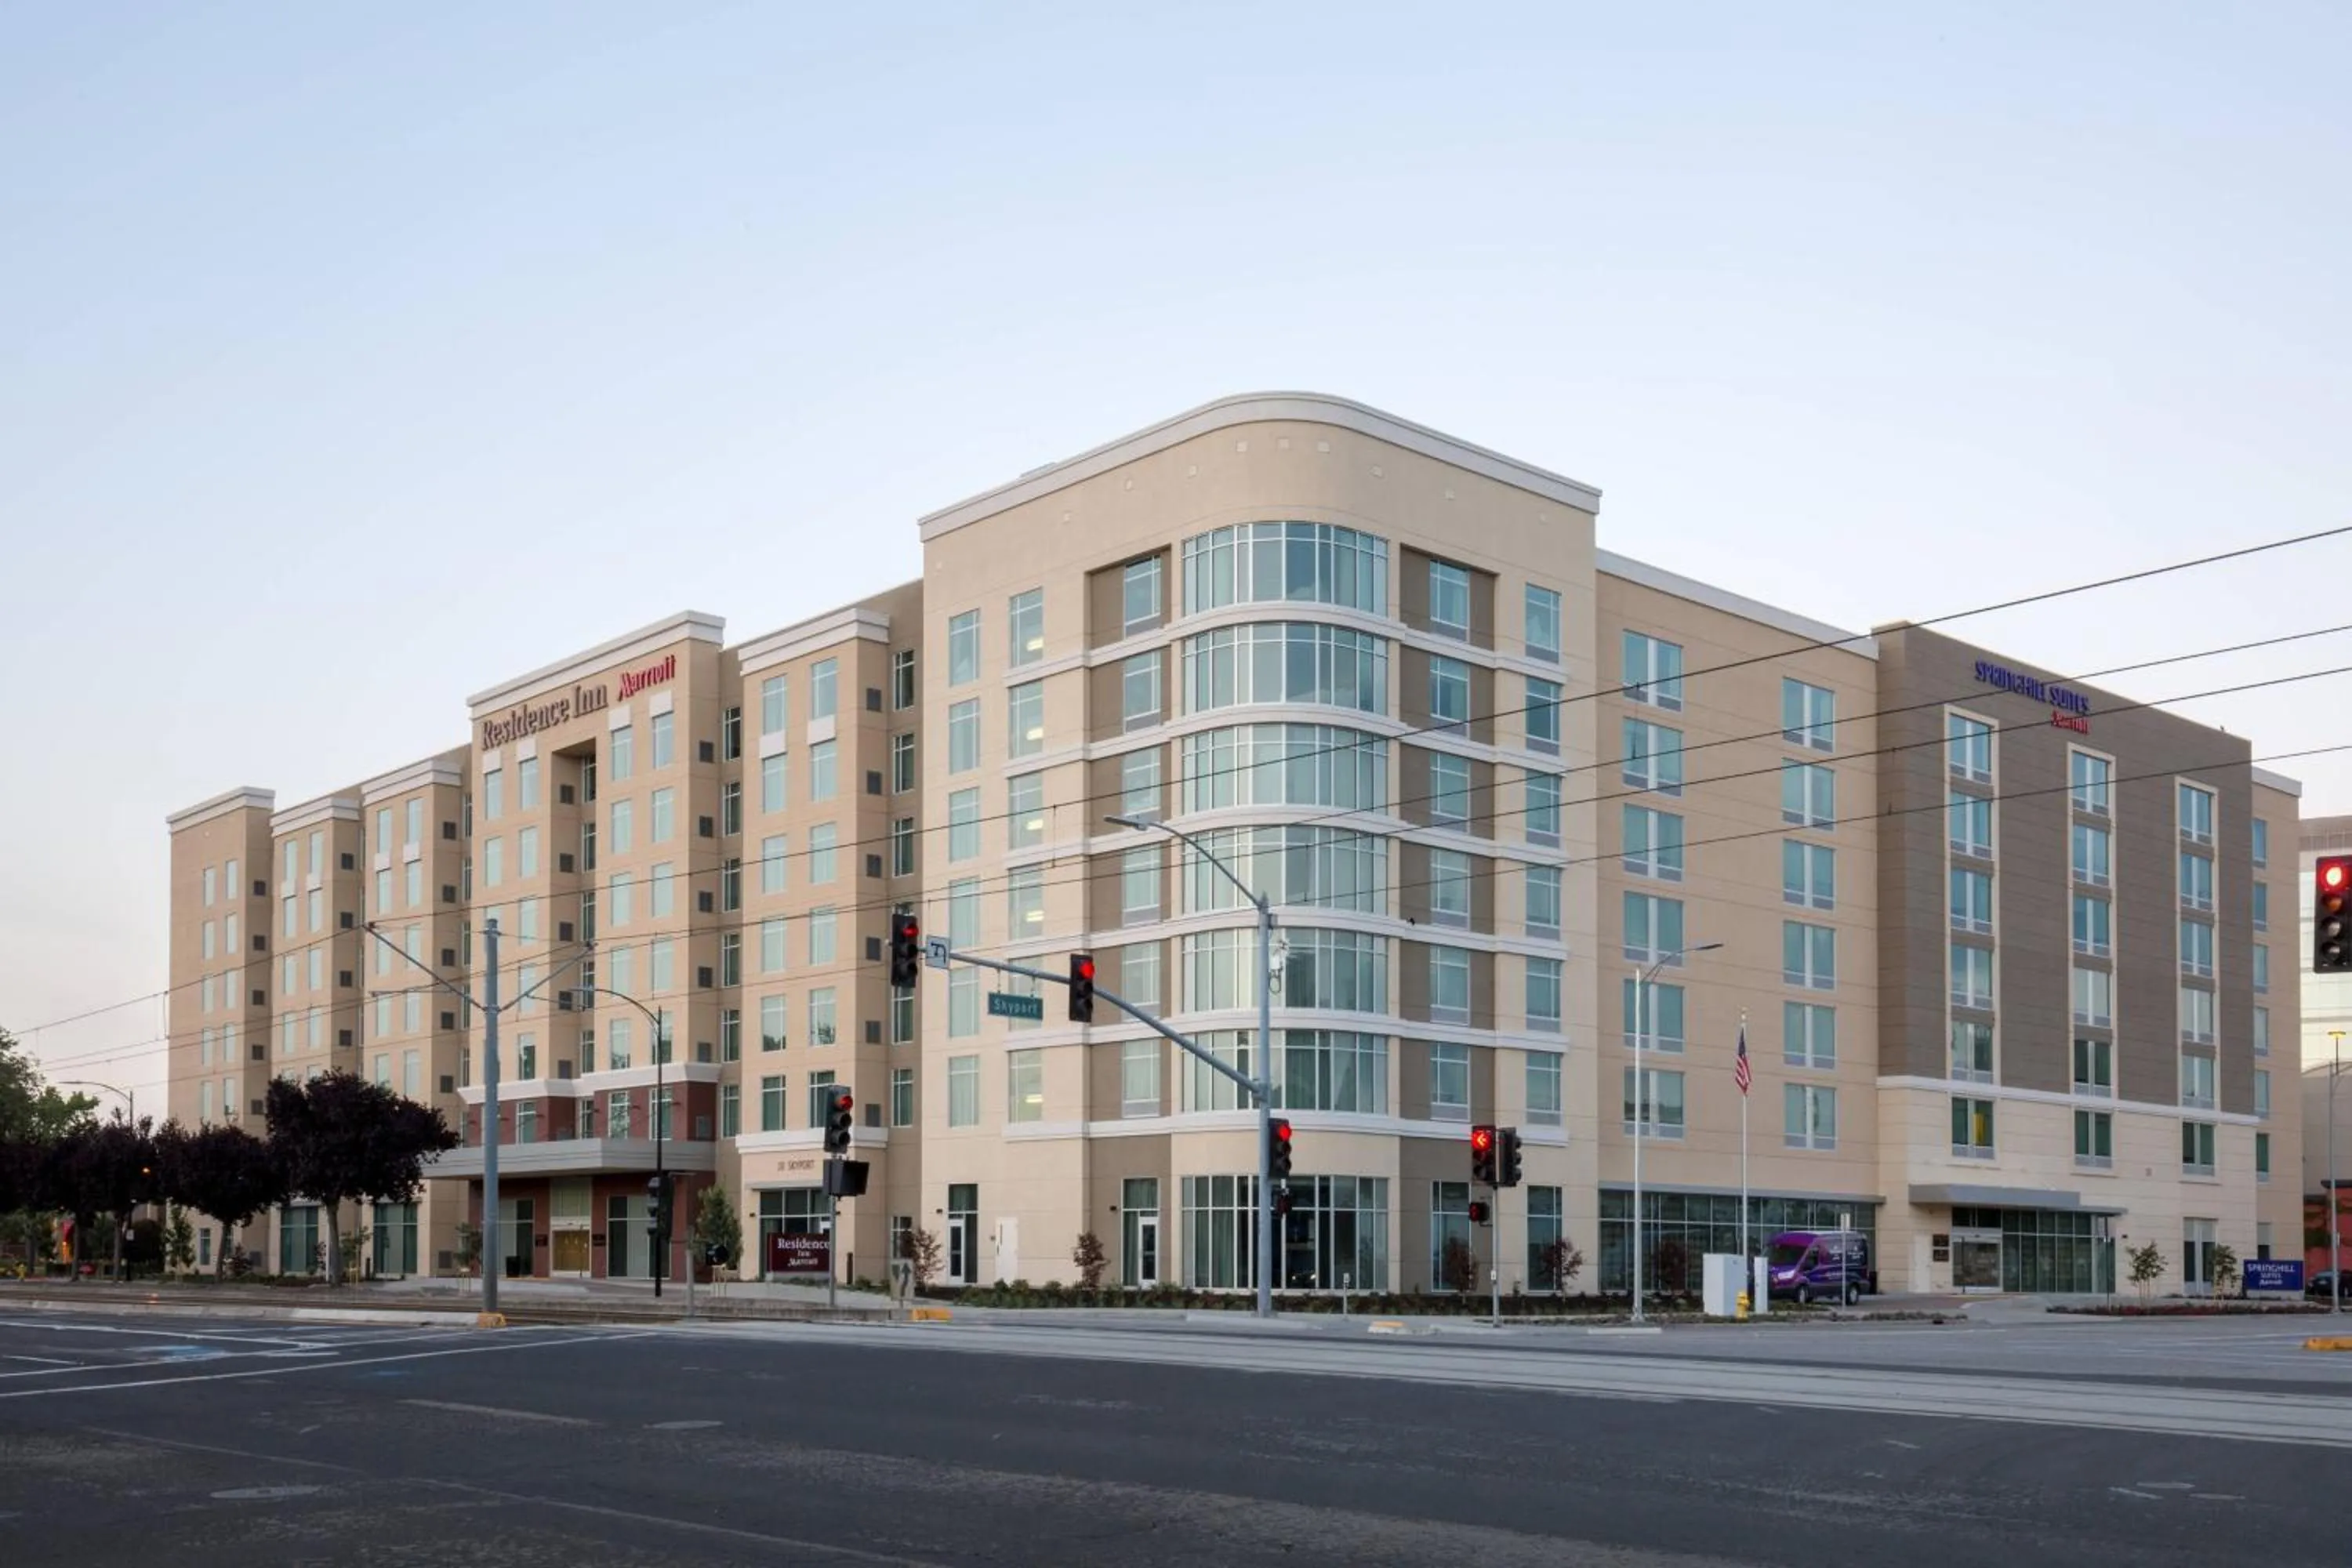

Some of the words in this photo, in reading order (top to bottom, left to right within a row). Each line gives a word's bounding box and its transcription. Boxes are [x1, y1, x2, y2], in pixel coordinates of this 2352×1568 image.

[482, 699, 570, 751] Residence
[573, 684, 609, 719] Inn
[993, 998, 1038, 1014] Skyport
